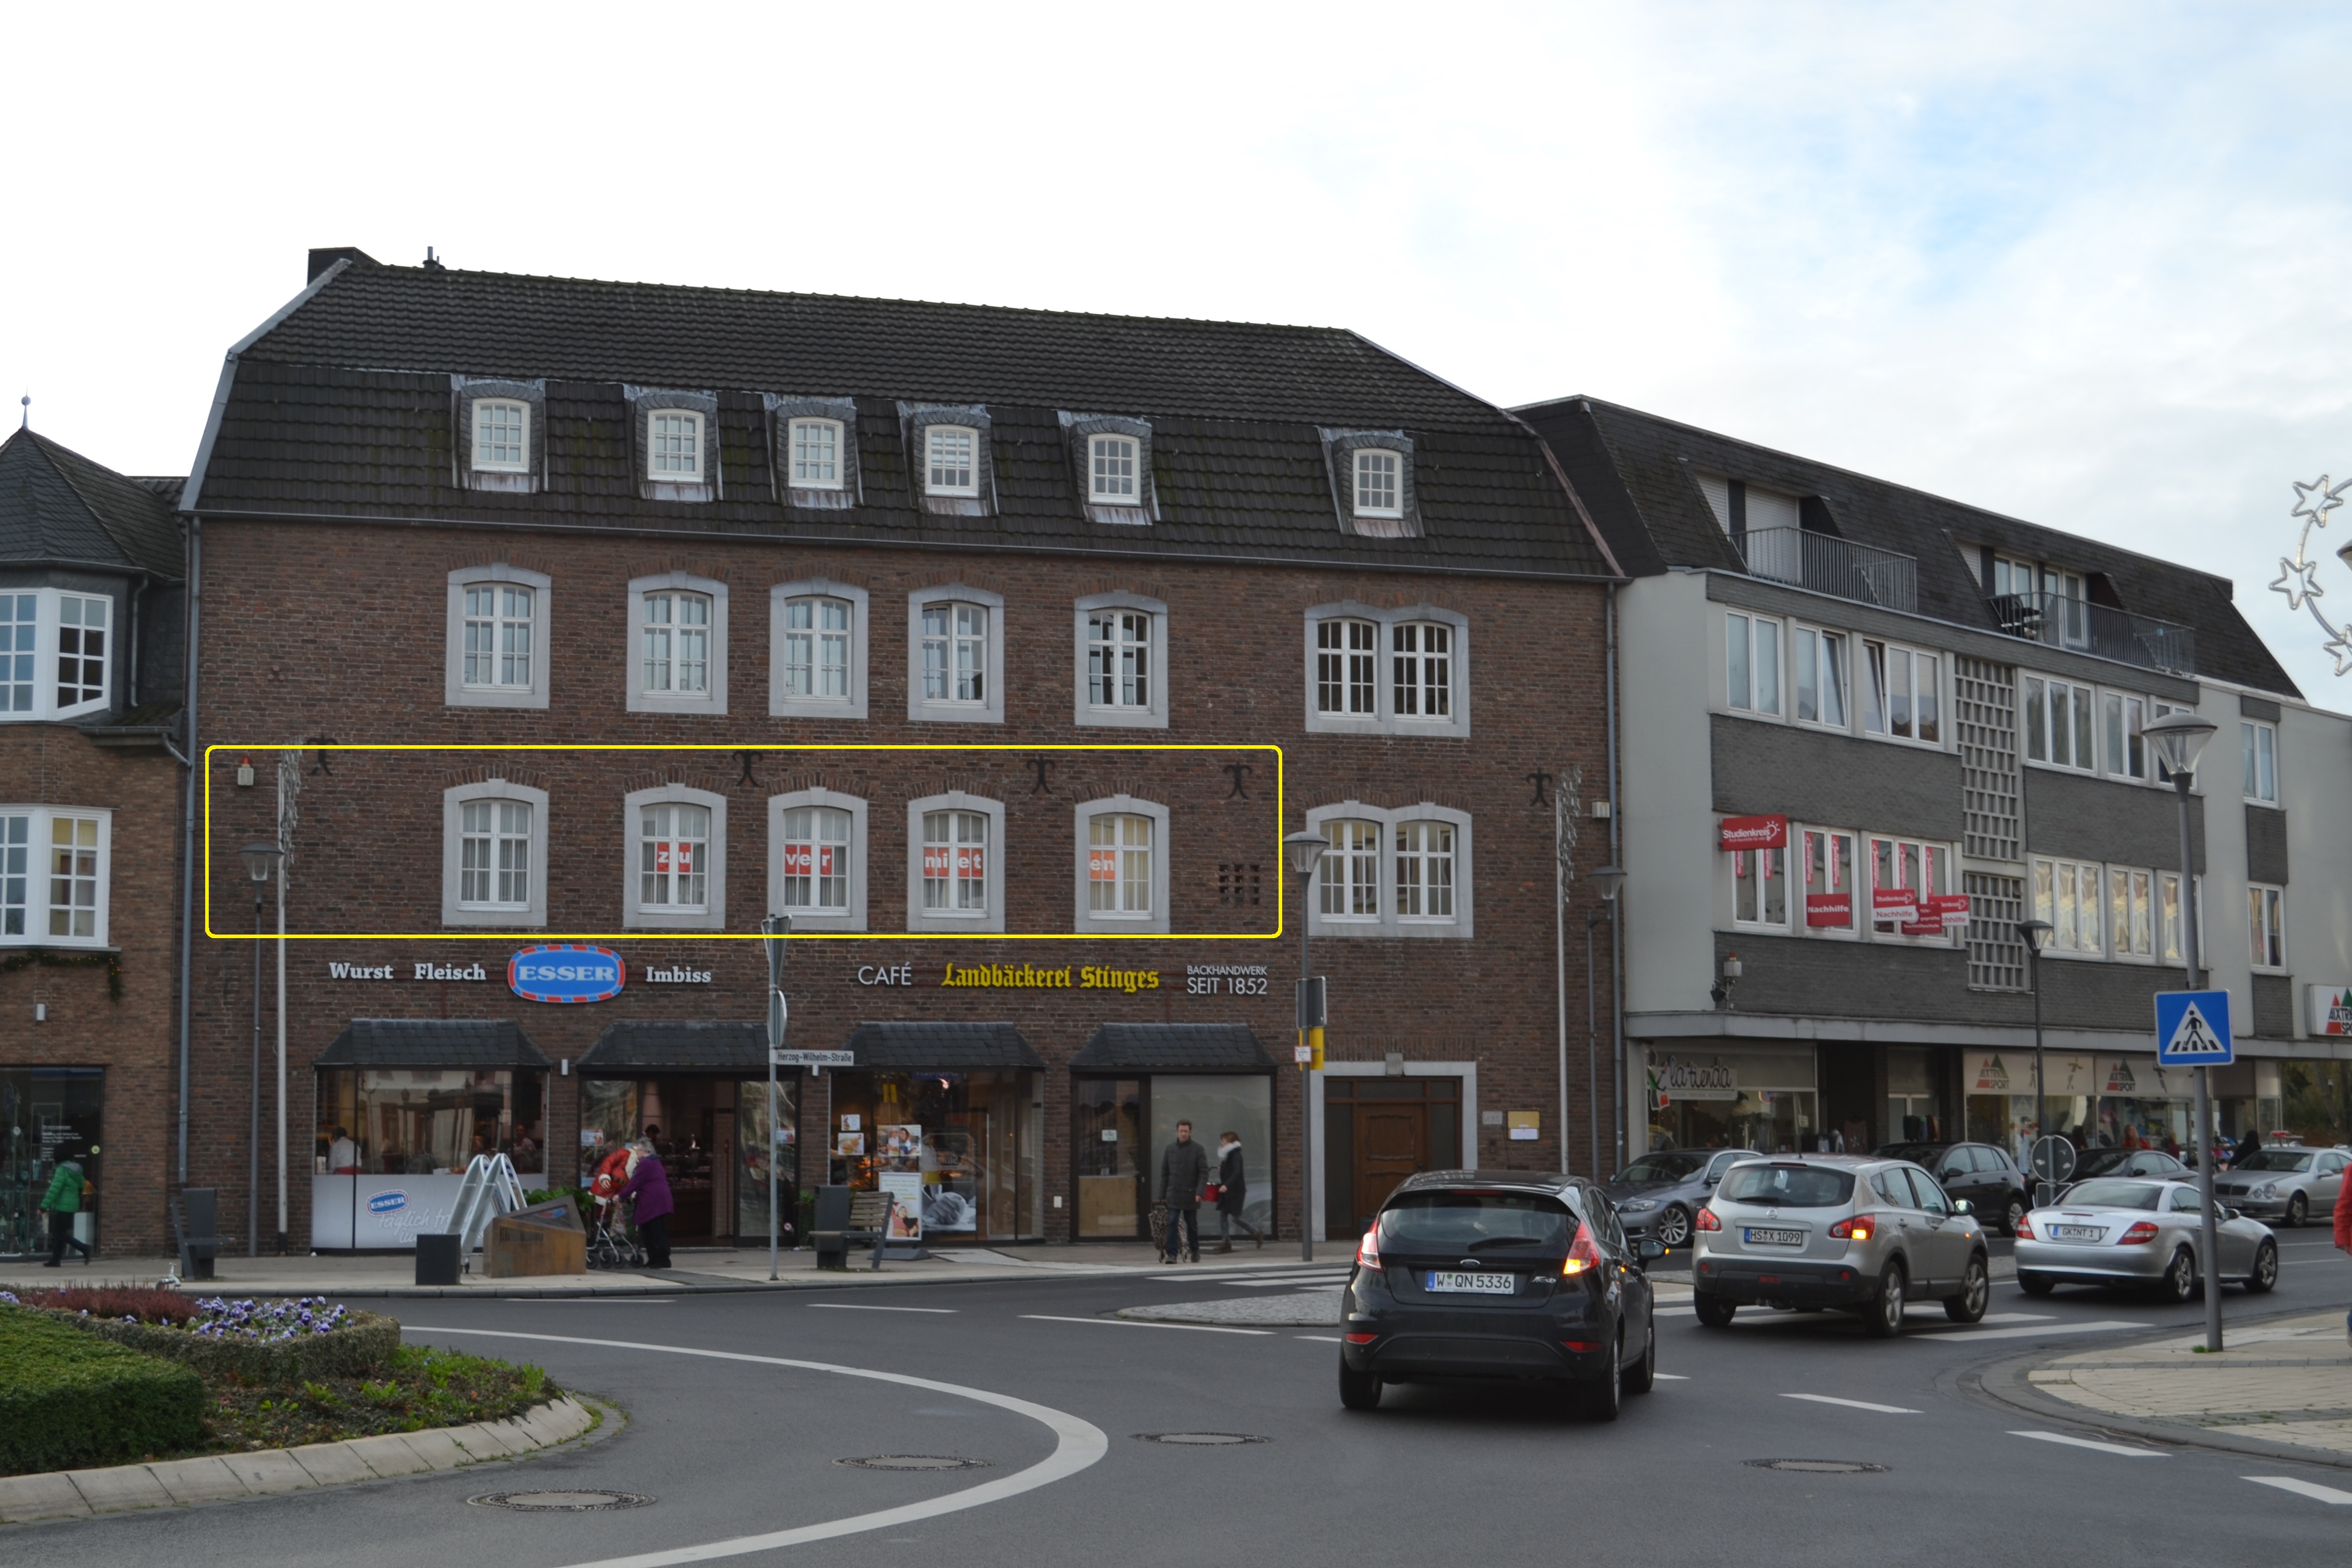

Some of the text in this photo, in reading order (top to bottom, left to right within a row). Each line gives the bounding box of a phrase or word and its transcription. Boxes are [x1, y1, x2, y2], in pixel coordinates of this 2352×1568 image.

[1723, 827, 1771, 839] Studienkreis
[1808, 904, 1849, 913] Nachhilfe
[329, 962, 394, 979] Wurst
[414, 963, 486, 981] Fleisch
[518, 966, 616, 981] ESSER
[646, 966, 712, 983] Imbiss
[857, 961, 912, 986] CAFÉ
[940, 962, 1159, 993] Landbäckerei Stinges
[1187, 965, 1267, 975] BACKHANDWERK
[1187, 977, 1267, 995] SEIT 1852
[777, 1051, 852, 1063] Herzog-Wilhelm-Straße
[1669, 1056, 1732, 1089] la tienda
[1990, 1080, 2010, 1089] SPORT
[2118, 1083, 2136, 1092] SPORT
[370, 1196, 406, 1210] ESSER
[378, 1208, 430, 1236] täglich
[1750, 1230, 1800, 1242] HS X 1099
[2063, 1228, 2072, 1236] GK
[2076, 1229, 2087, 1237] NT
[1436, 1273, 1512, 1289] W QN 5336
